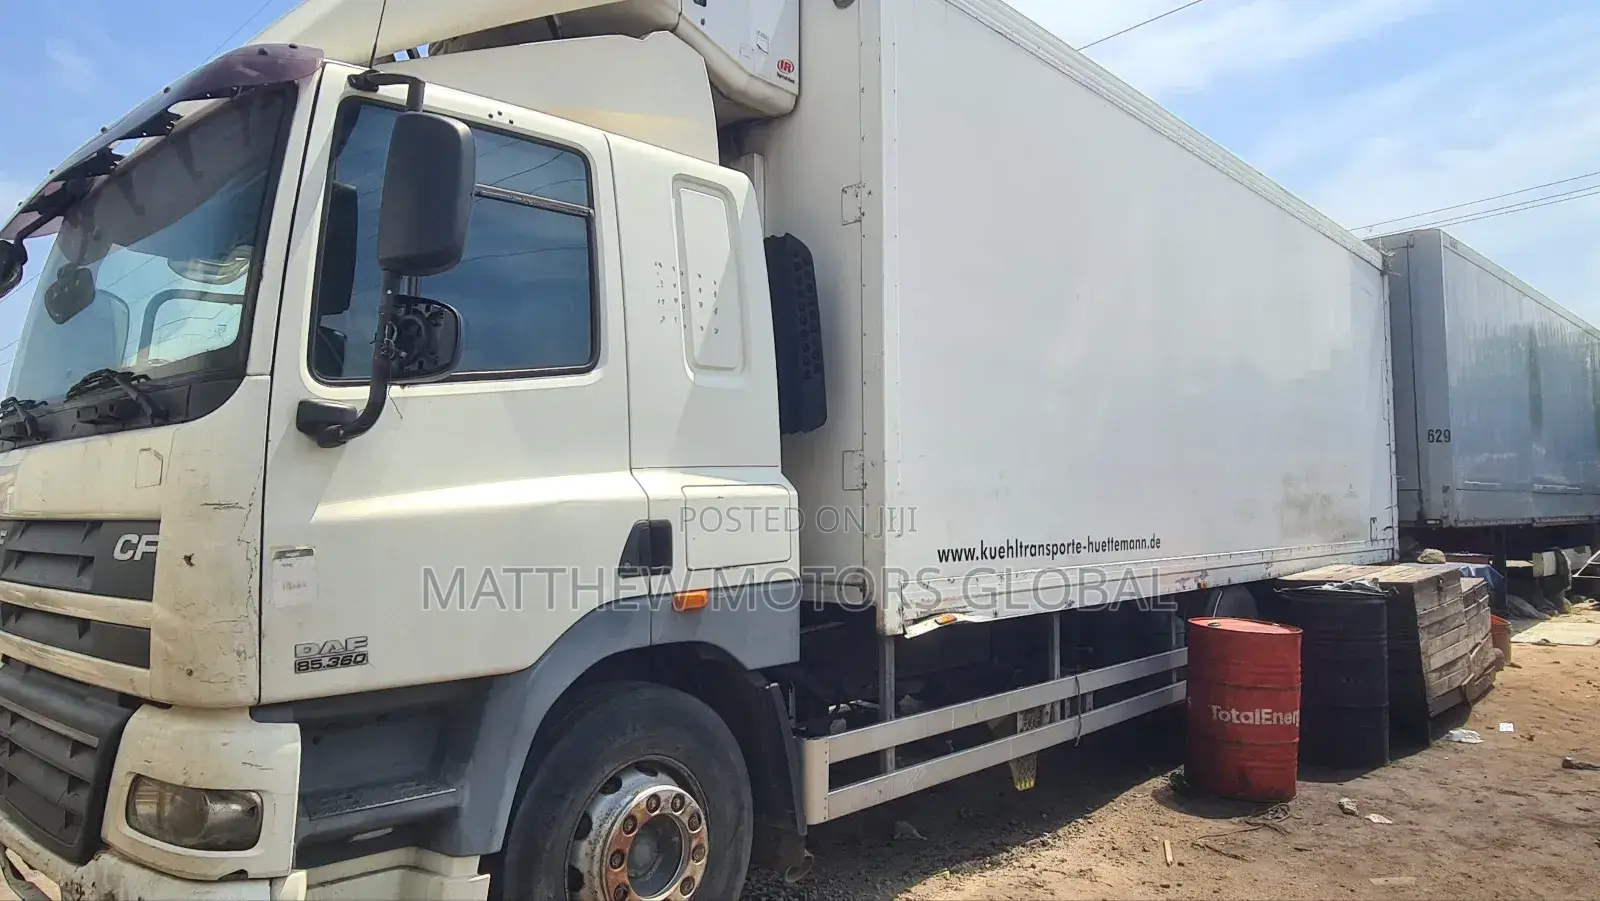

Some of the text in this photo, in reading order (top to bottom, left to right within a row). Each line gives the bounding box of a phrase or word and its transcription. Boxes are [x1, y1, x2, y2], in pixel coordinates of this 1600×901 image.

[1427, 429, 1451, 443] 629
[113, 533, 159, 561] CF
[937, 533, 1161, 563] www.kuehltransporte-huettemann.de
[294, 636, 368, 658] DAF
[296, 653, 367, 672] 85.360
[1209, 704, 1300, 727] TotalEner
